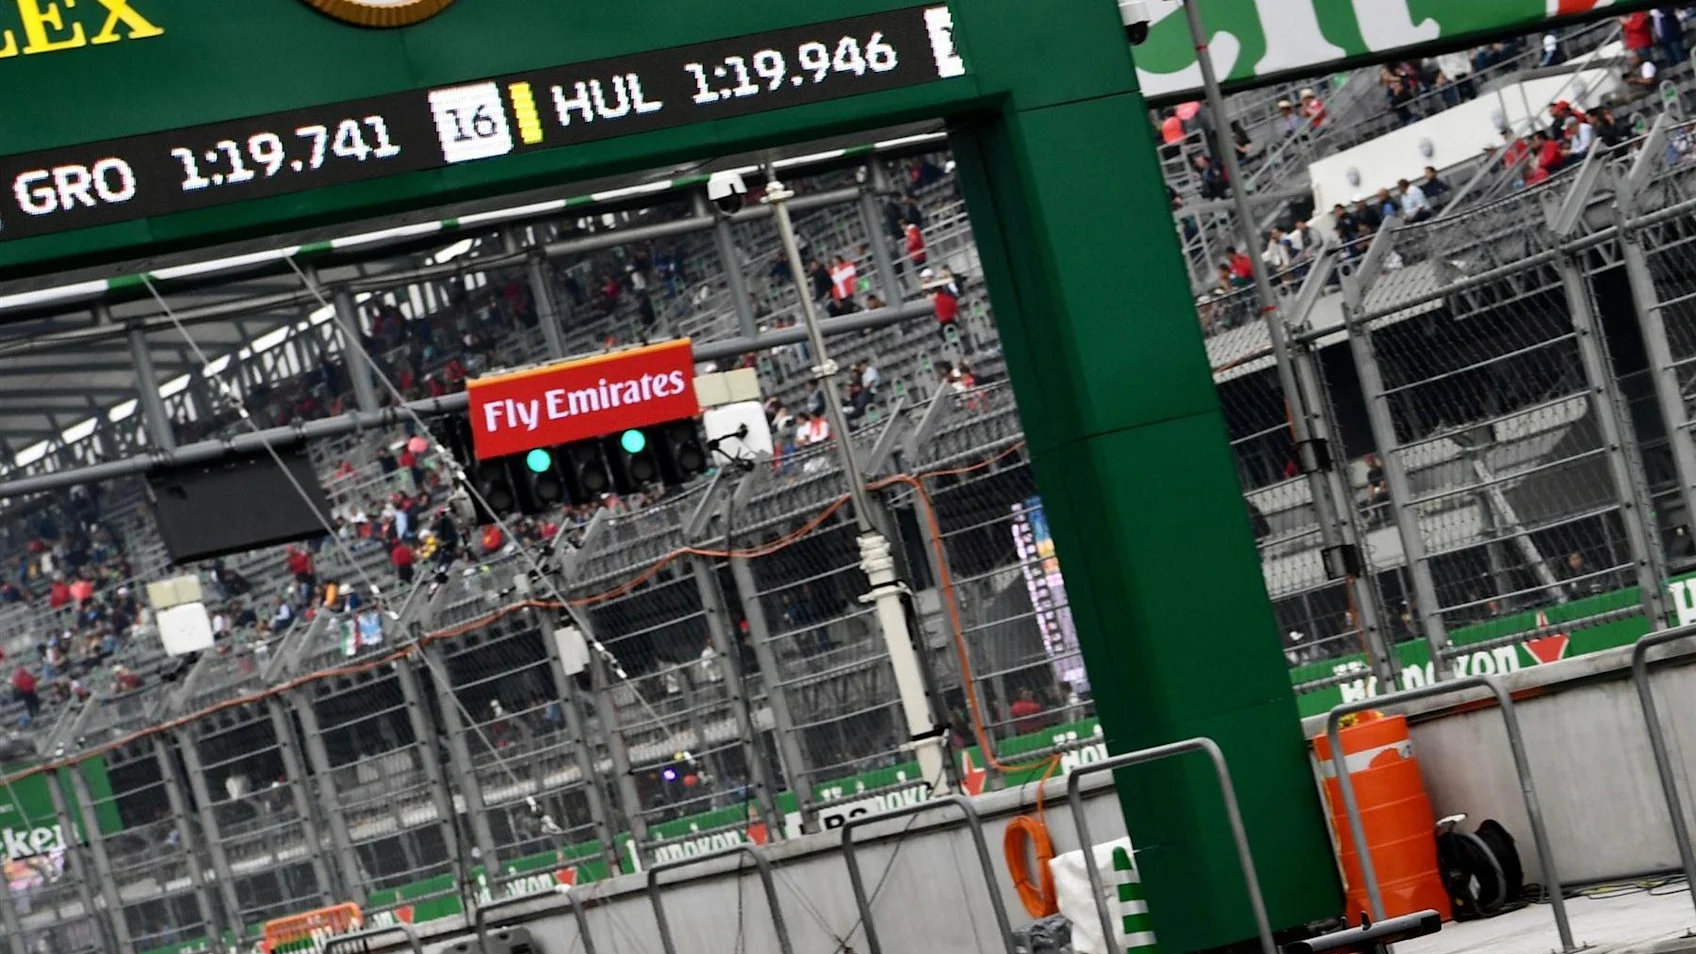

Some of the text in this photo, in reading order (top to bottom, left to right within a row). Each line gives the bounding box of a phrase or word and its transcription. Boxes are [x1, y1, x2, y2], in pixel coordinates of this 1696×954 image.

[13, 157, 136, 216] GRO
[170, 115, 400, 191] 1:19.741
[445, 103, 499, 142] 16
[551, 73, 663, 126] HUL
[684, 31, 898, 104] 1:19.946
[483, 370, 685, 432] Fly Emirates
